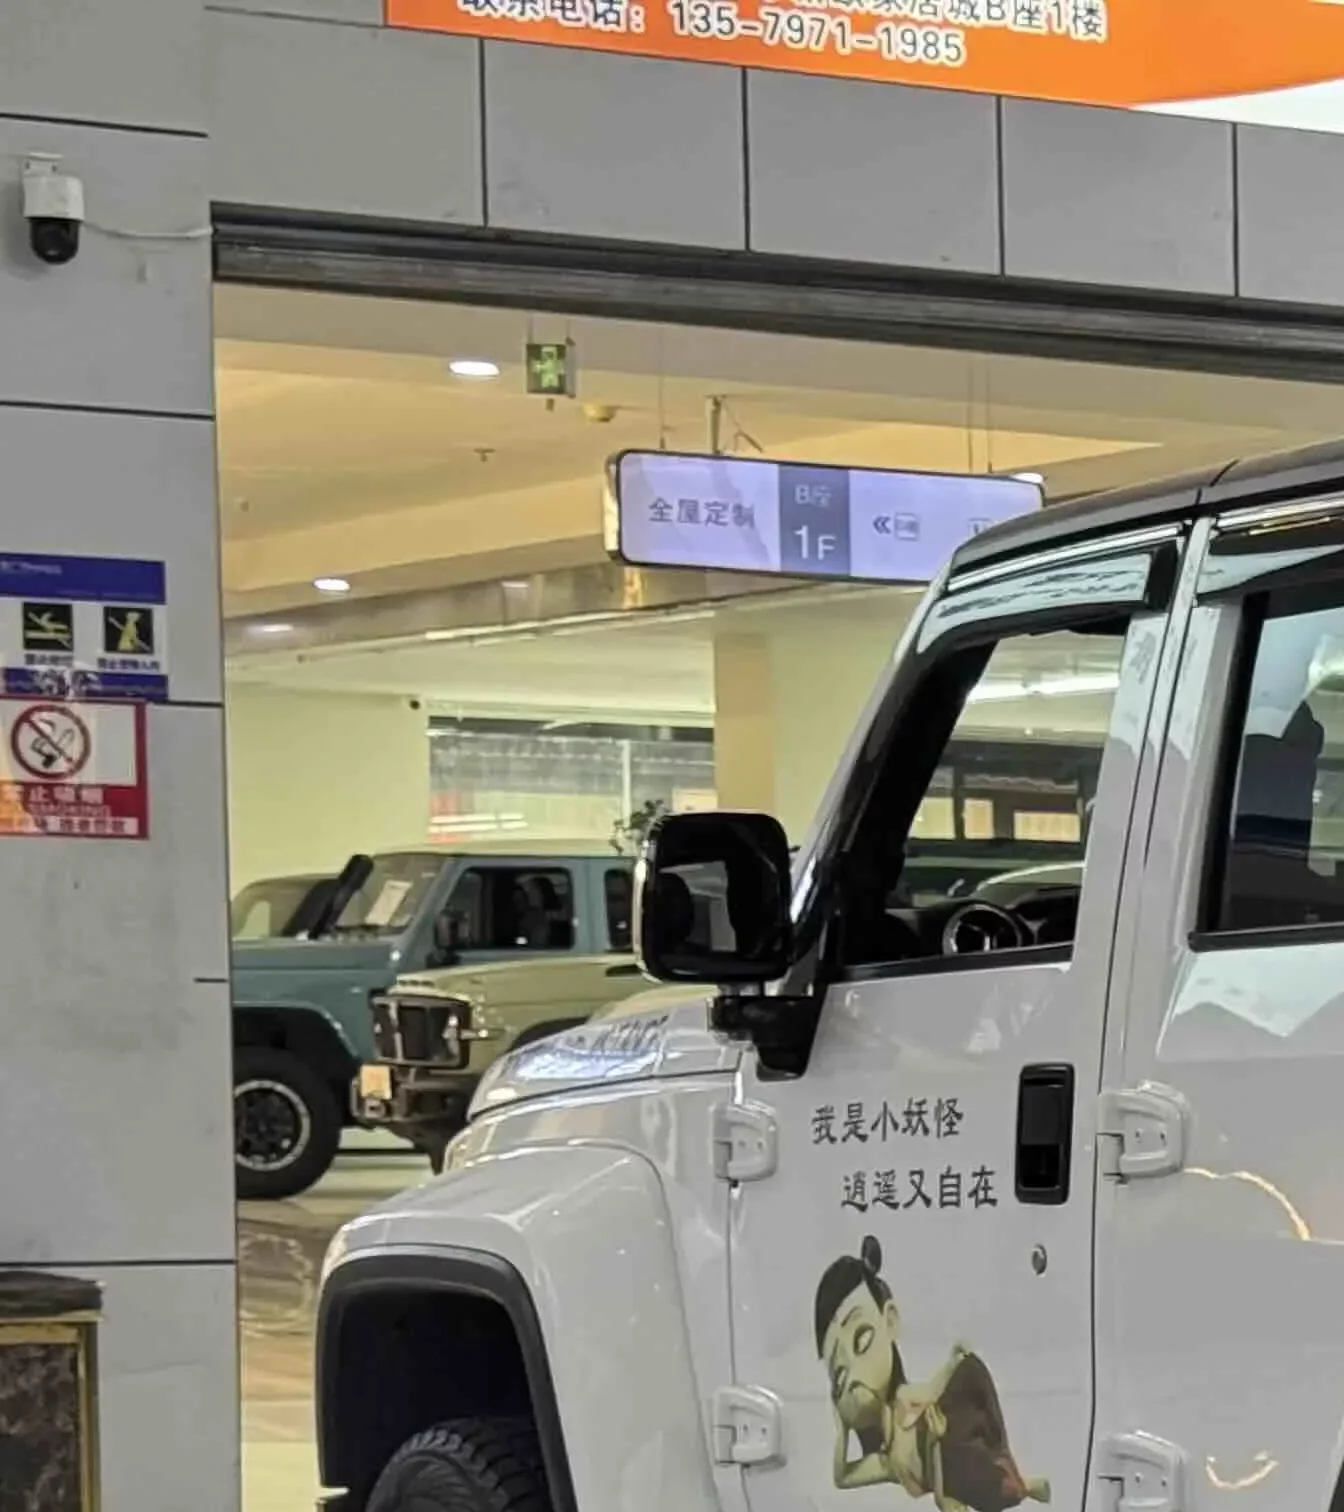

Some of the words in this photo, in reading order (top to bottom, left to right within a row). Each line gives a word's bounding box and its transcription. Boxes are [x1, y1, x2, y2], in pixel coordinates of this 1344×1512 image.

[671, 2, 962, 63] 135-7971-1985
[648, 497, 756, 528] 全屋定制
[794, 525, 837, 560] 1F
[811, 1097, 964, 1145] 我是小妖怪
[840, 1164, 999, 1213] 逍遥又自在
